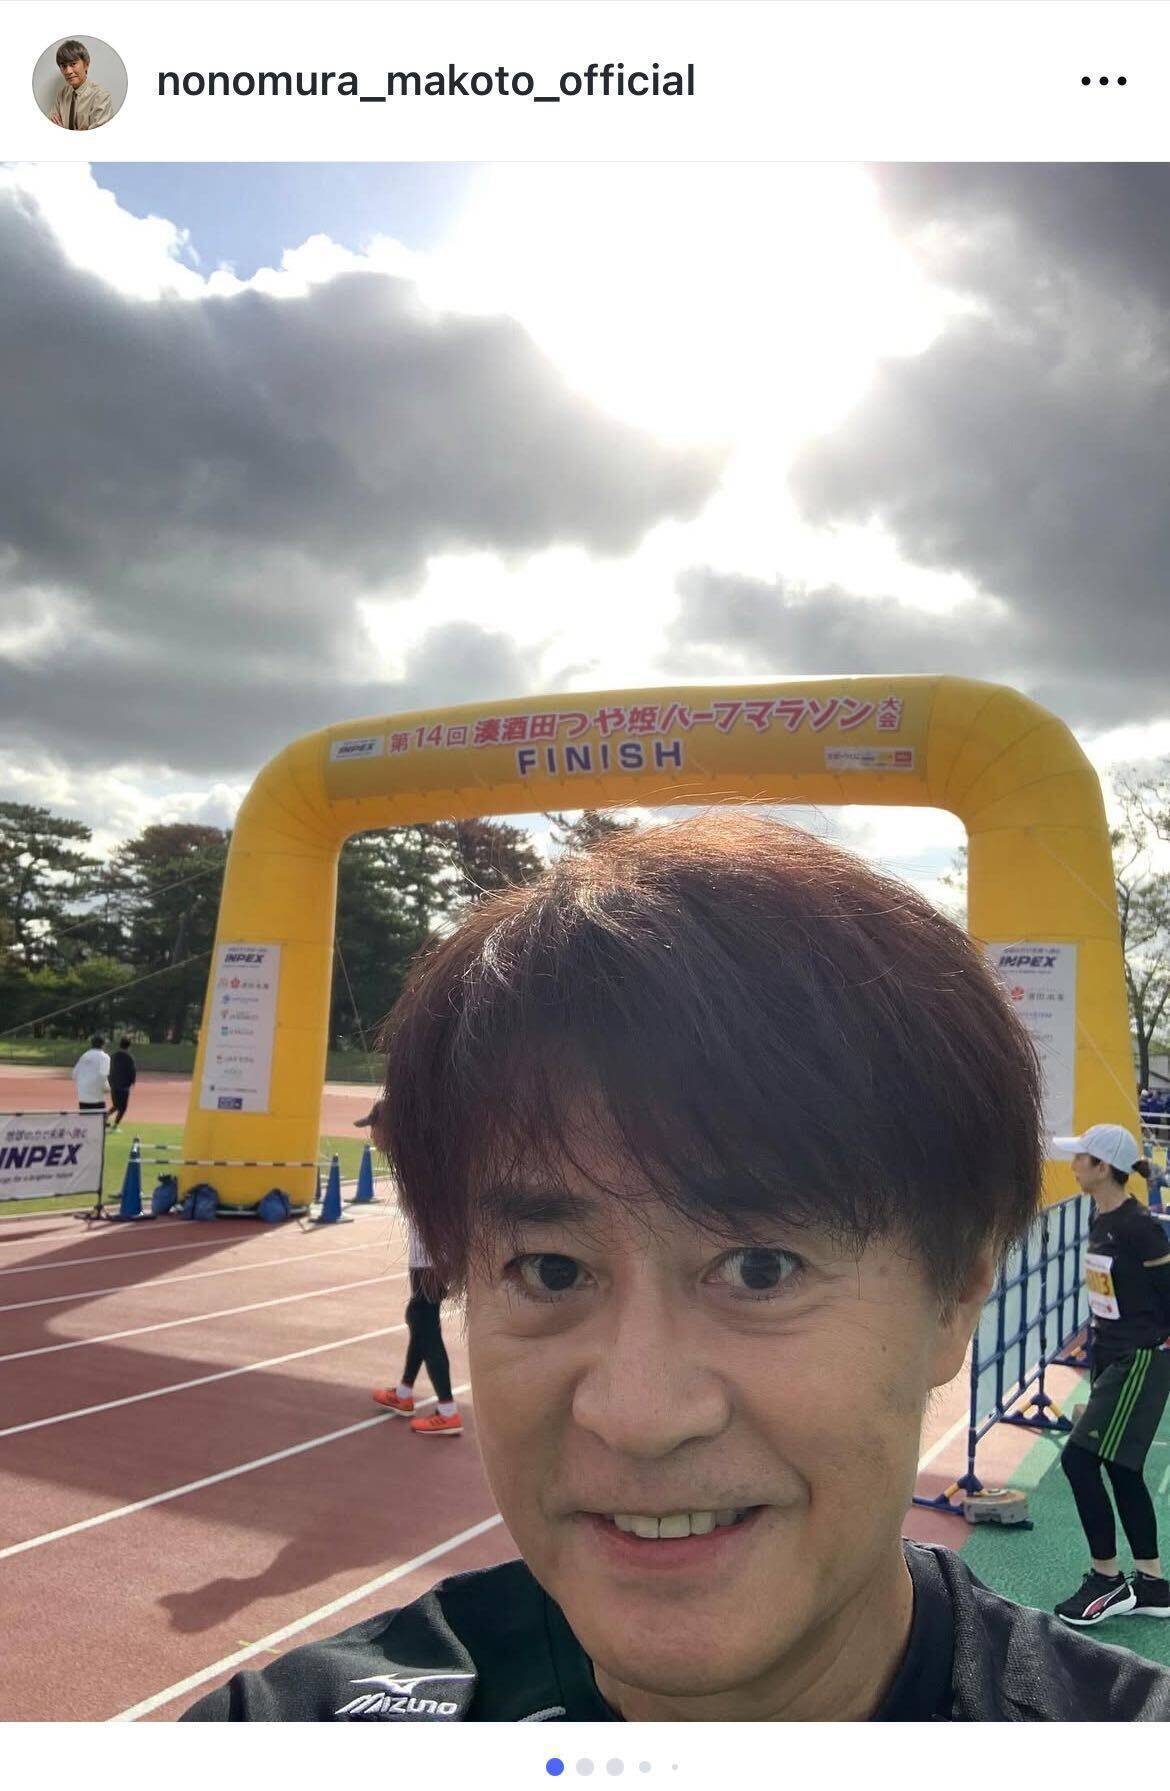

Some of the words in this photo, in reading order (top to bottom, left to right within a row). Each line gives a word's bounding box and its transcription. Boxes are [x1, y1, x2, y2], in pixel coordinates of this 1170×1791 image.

[390, 723, 468, 753] 第14回
[878, 696, 901, 730] 大会
[337, 743, 376, 754] INPEX
[518, 741, 682, 775] FINISH
[224, 953, 264, 964] INPEX
[999, 955, 1057, 967] INPEX
[0, 1143, 82, 1169] INPEX
